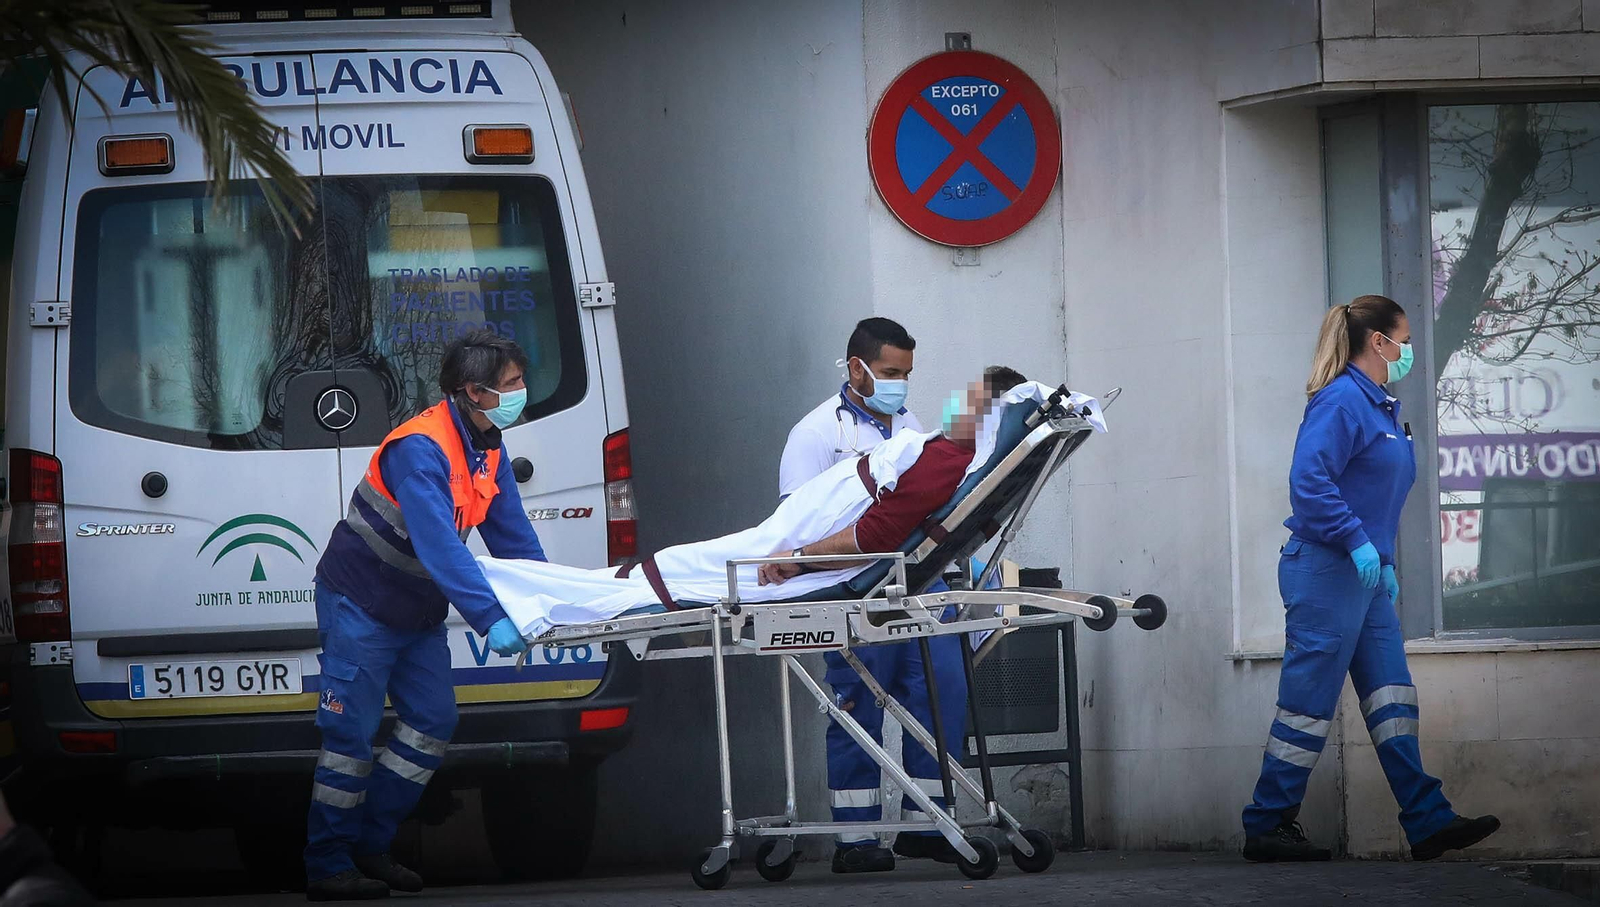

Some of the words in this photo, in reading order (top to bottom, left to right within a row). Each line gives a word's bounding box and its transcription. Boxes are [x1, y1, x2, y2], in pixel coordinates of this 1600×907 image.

[120, 57, 502, 107] AULANCIA
[931, 84, 1000, 98] EXCEPTO
[951, 103, 978, 116] 061
[301, 123, 405, 150] MOVIL
[387, 266, 499, 283] TRASLADO
[504, 266, 532, 282] DE
[390, 289, 536, 313] PACIENTES
[528, 507, 560, 521] 315
[561, 507, 593, 519] CDI
[76, 522, 175, 537] SPRINTER
[195, 592, 232, 607] JUNTA
[238, 591, 253, 605] DE
[770, 630, 835, 646] FERNO
[154, 665, 224, 694] 5119
[236, 662, 289, 691] GYR
[134, 684, 142, 692] E
